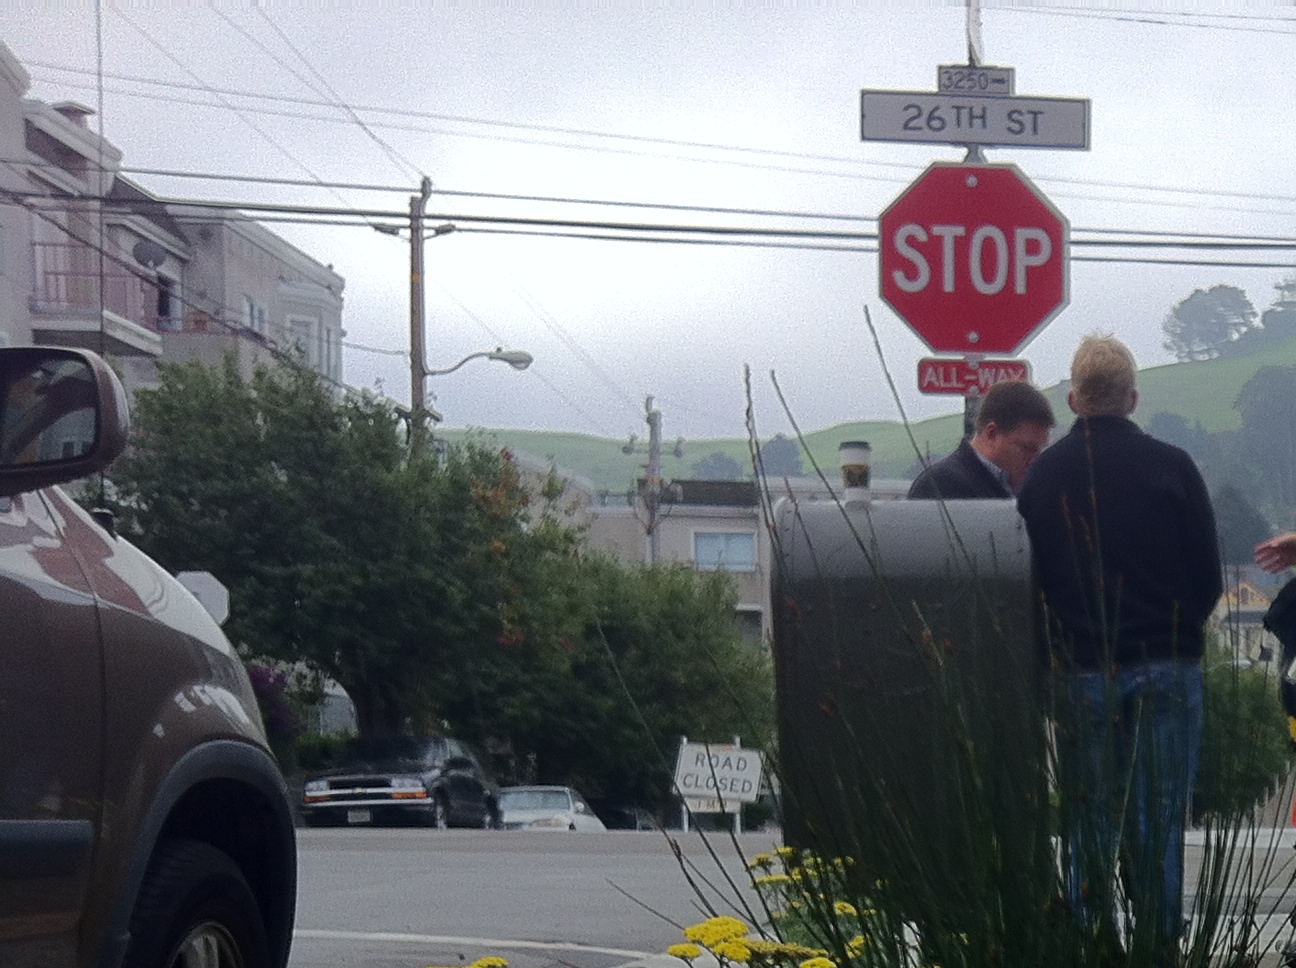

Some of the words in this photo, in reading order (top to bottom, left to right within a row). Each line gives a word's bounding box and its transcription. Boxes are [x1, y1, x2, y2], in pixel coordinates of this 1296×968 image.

[942, 69, 989, 90] 3250
[902, 103, 987, 133] 26TH
[1006, 110, 1044, 136] ST
[892, 223, 1053, 296] STOP
[922, 366, 1024, 388] ALL-WAY
[695, 753, 748, 772] ROAD
[682, 773, 753, 794] CLOSED
